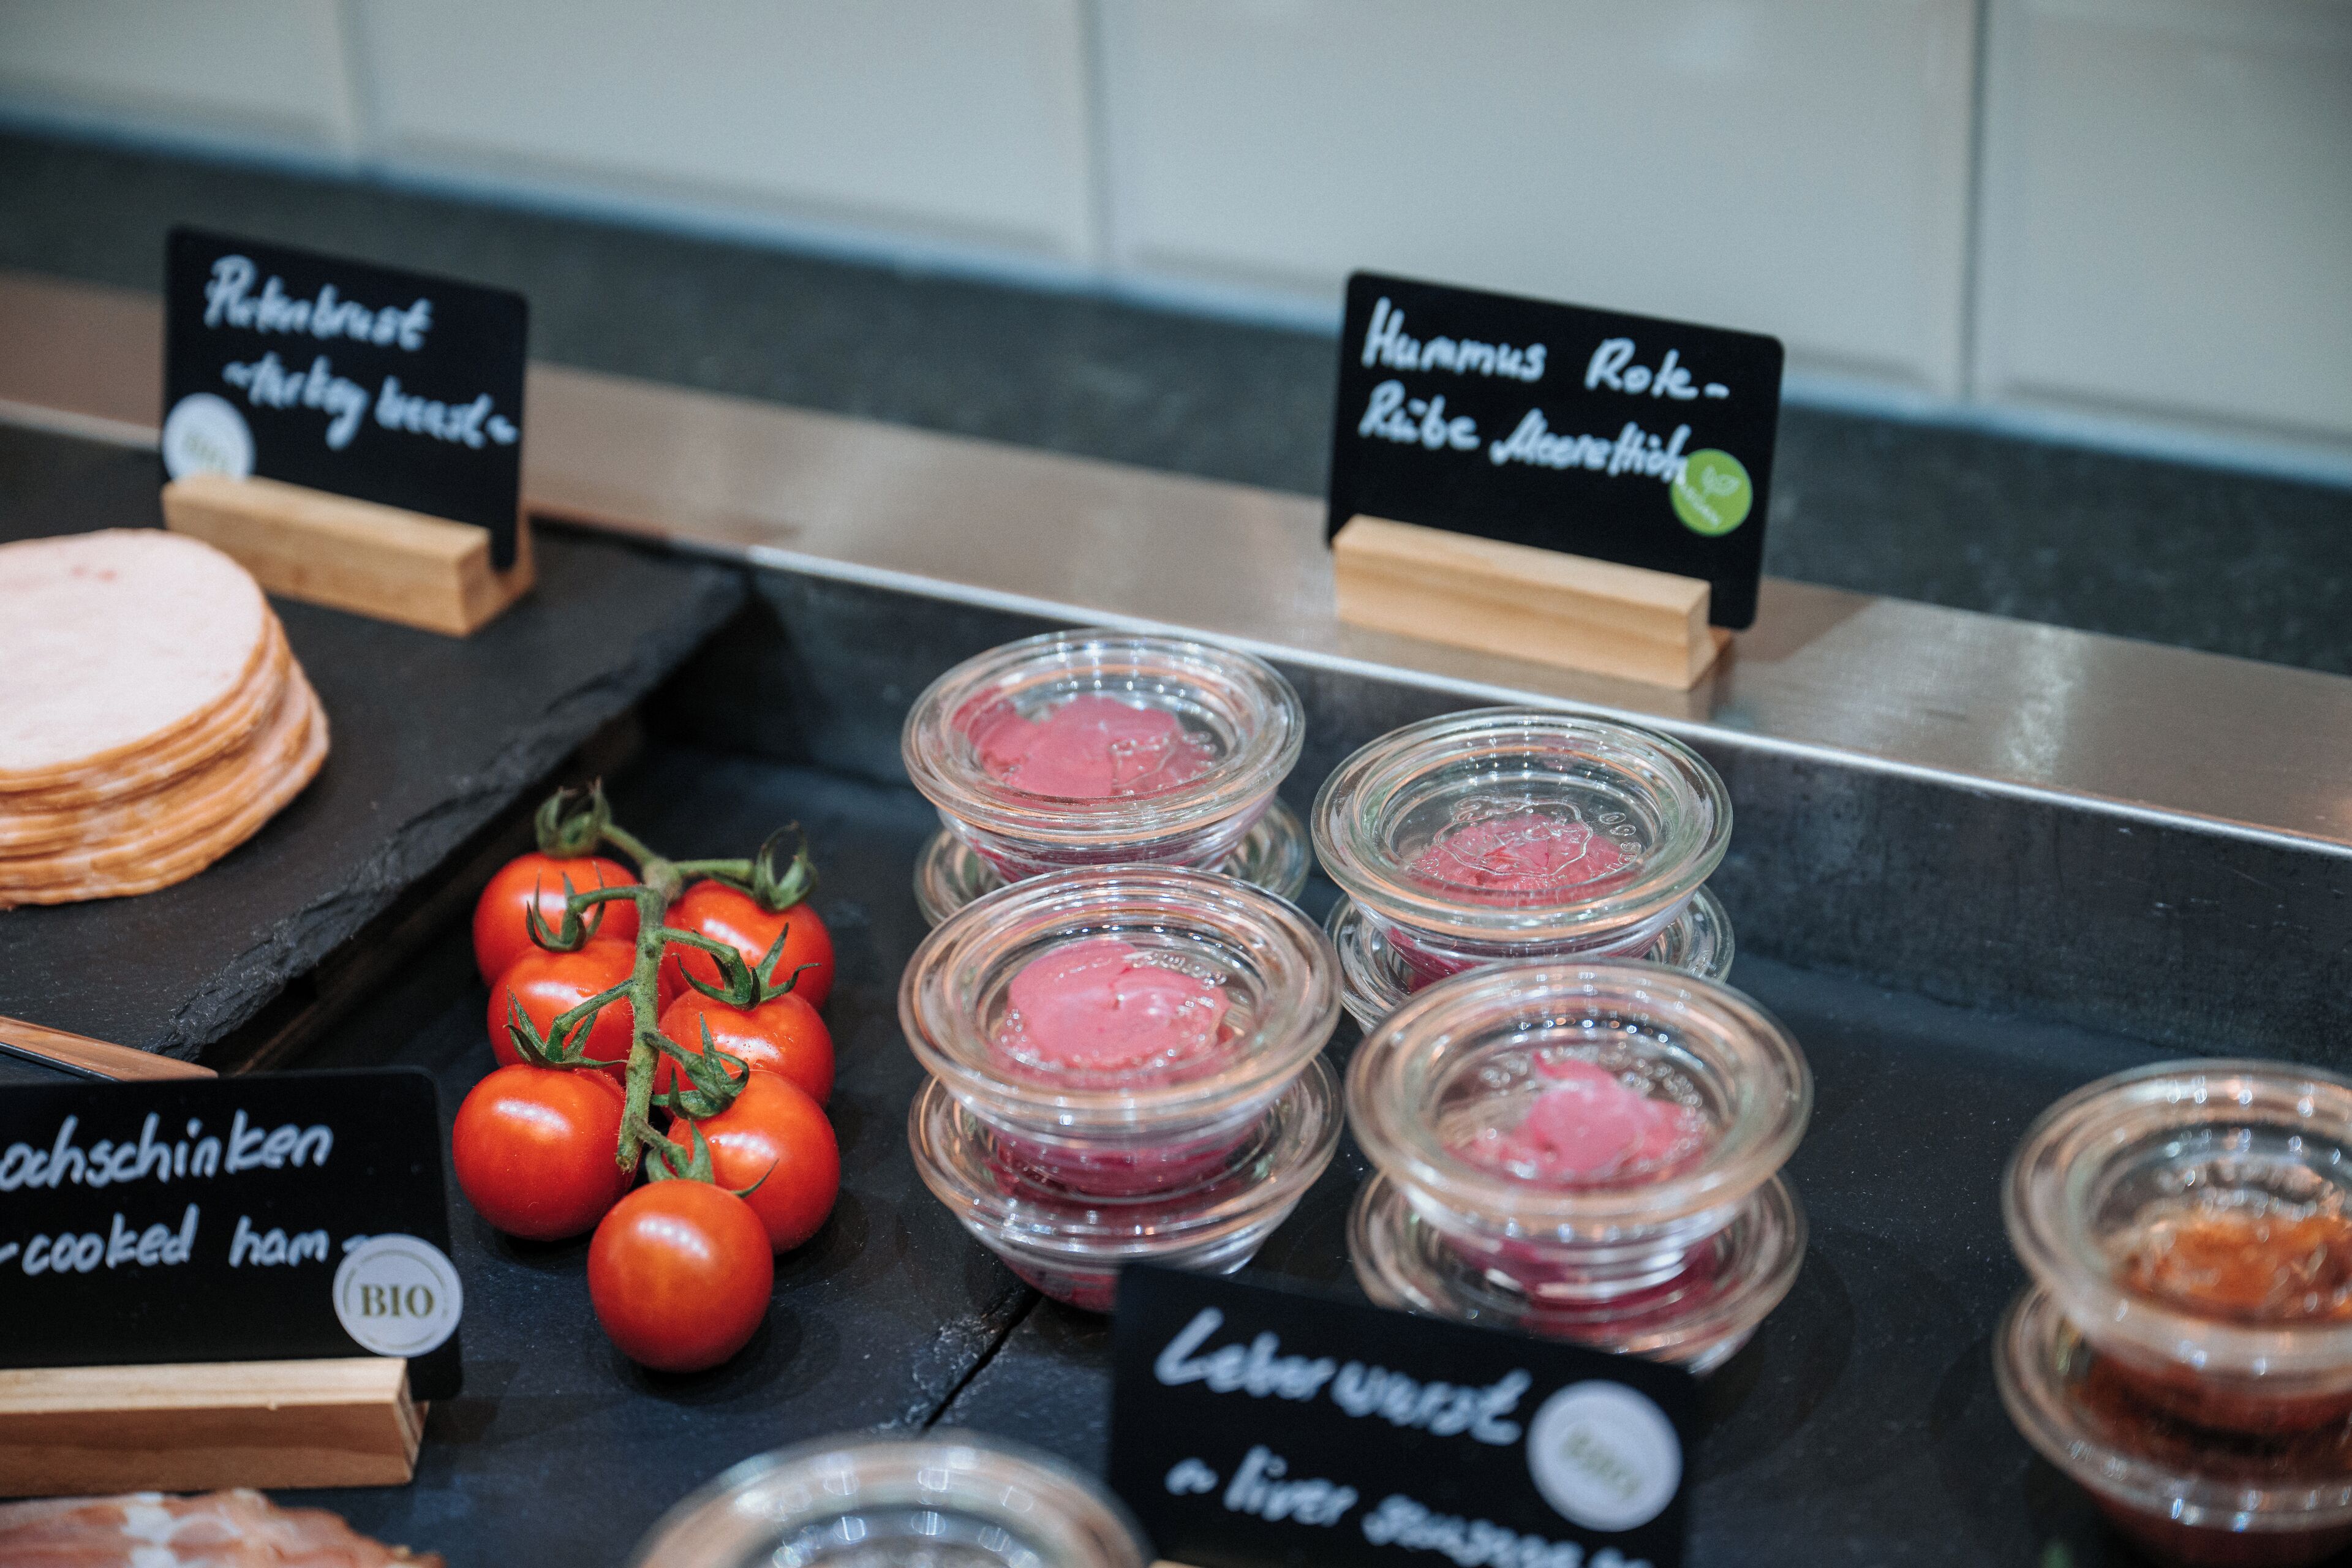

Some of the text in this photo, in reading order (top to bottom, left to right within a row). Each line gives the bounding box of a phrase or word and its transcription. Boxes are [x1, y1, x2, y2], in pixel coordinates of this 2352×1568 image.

[1361, 296, 1547, 382] Hummus
[1358, 379, 1480, 450] Rübe
[360, 1284, 434, 1317] BIO
